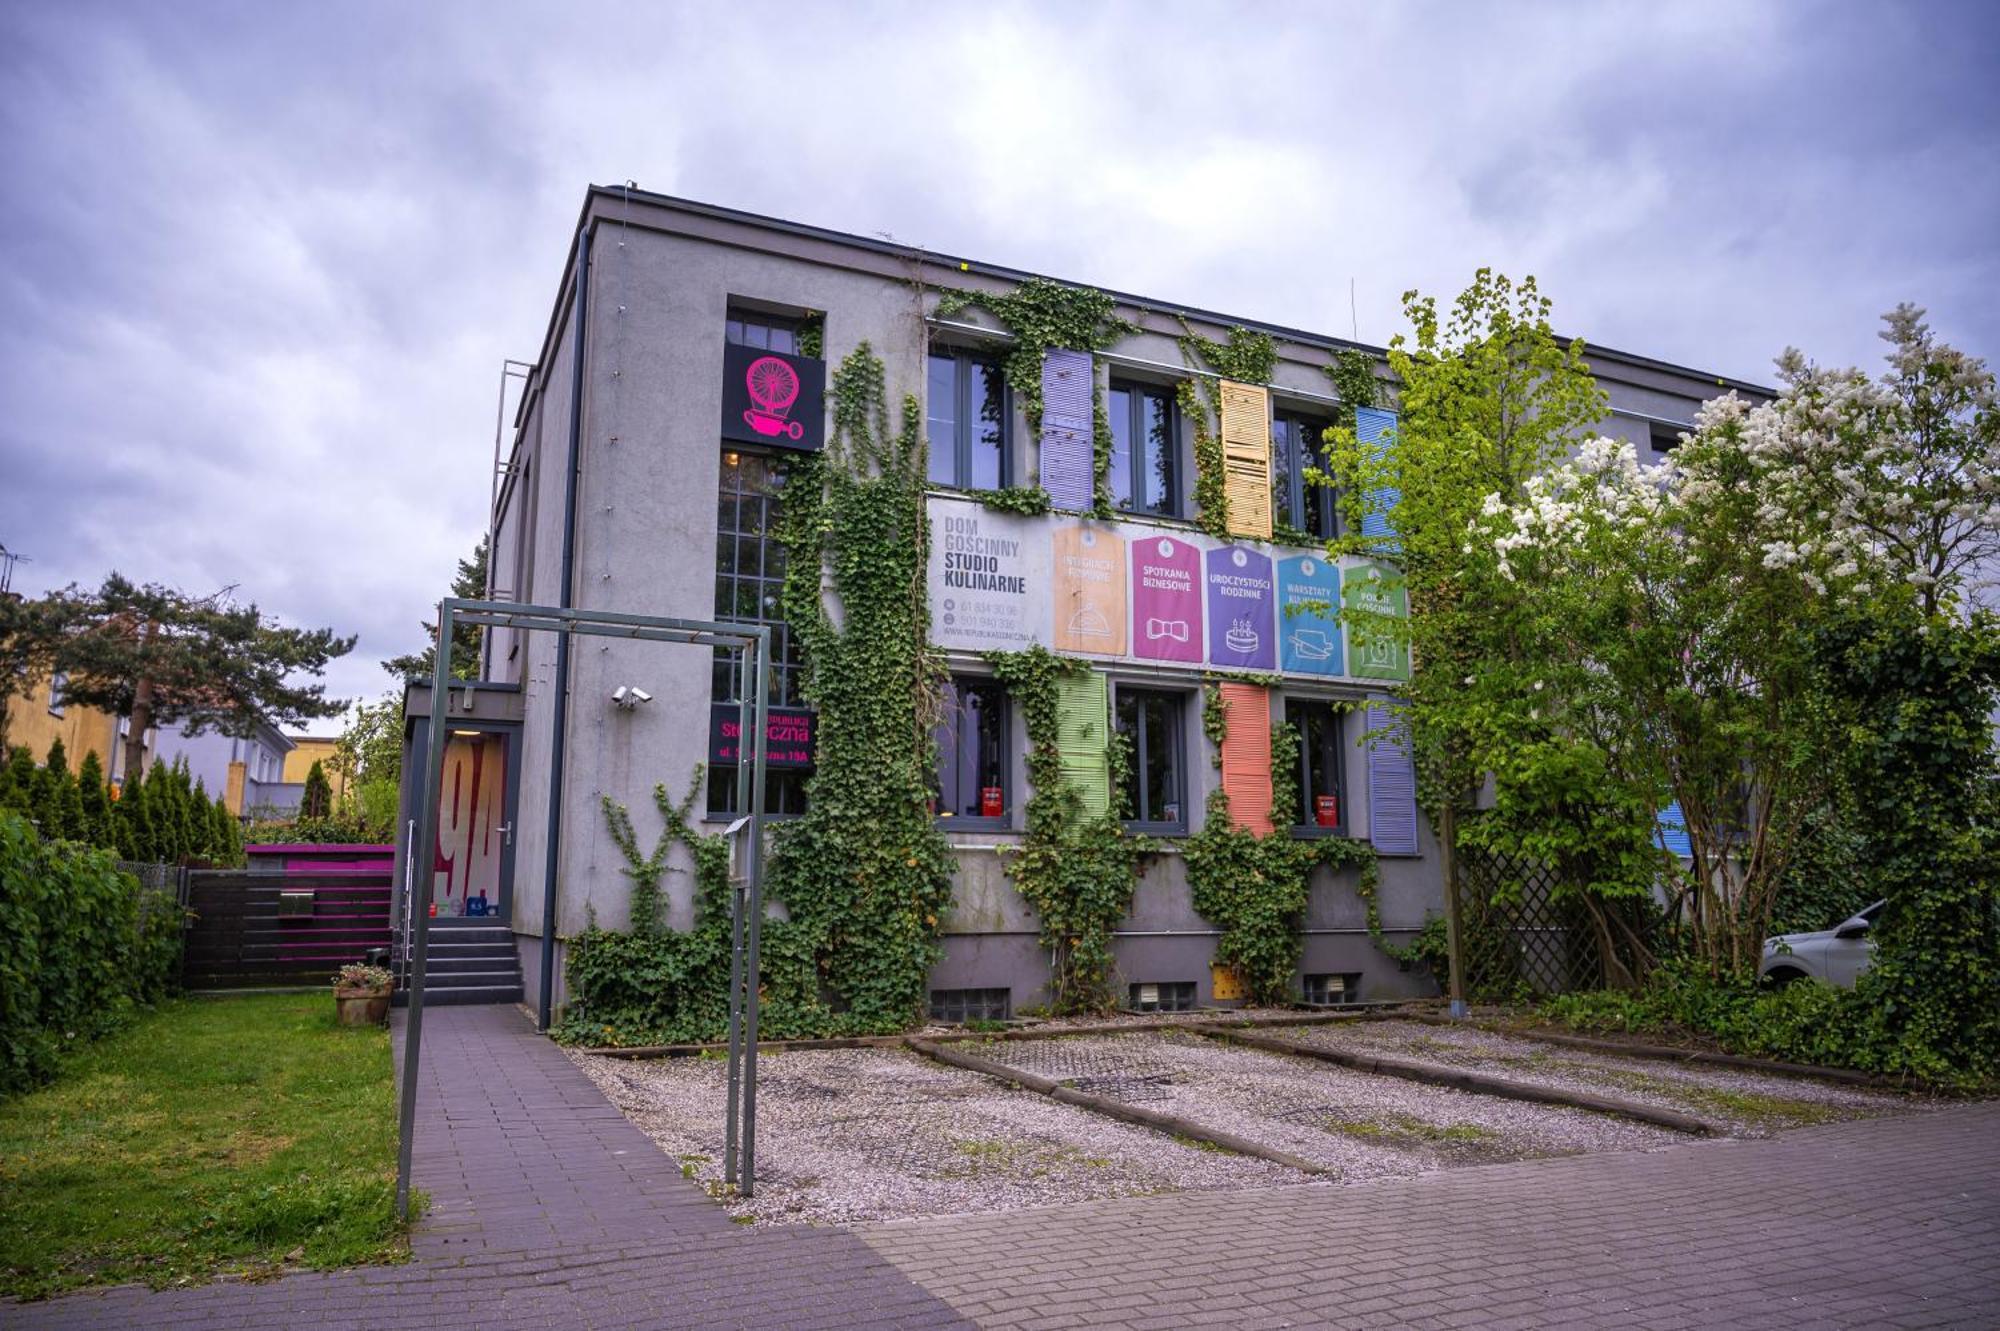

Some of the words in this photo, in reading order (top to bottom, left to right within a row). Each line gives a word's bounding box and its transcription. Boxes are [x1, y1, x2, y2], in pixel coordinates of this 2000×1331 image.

[945, 516, 978, 535] DOM
[945, 552, 998, 573] STUDIO
[1143, 565, 1190, 580] SPOTKANIA
[945, 570, 1026, 594] KULINARNE
[1143, 576, 1192, 592] BIZNESOWE
[1287, 583, 1331, 597] WARSZTATY
[1220, 585, 1262, 600] RODZINNE
